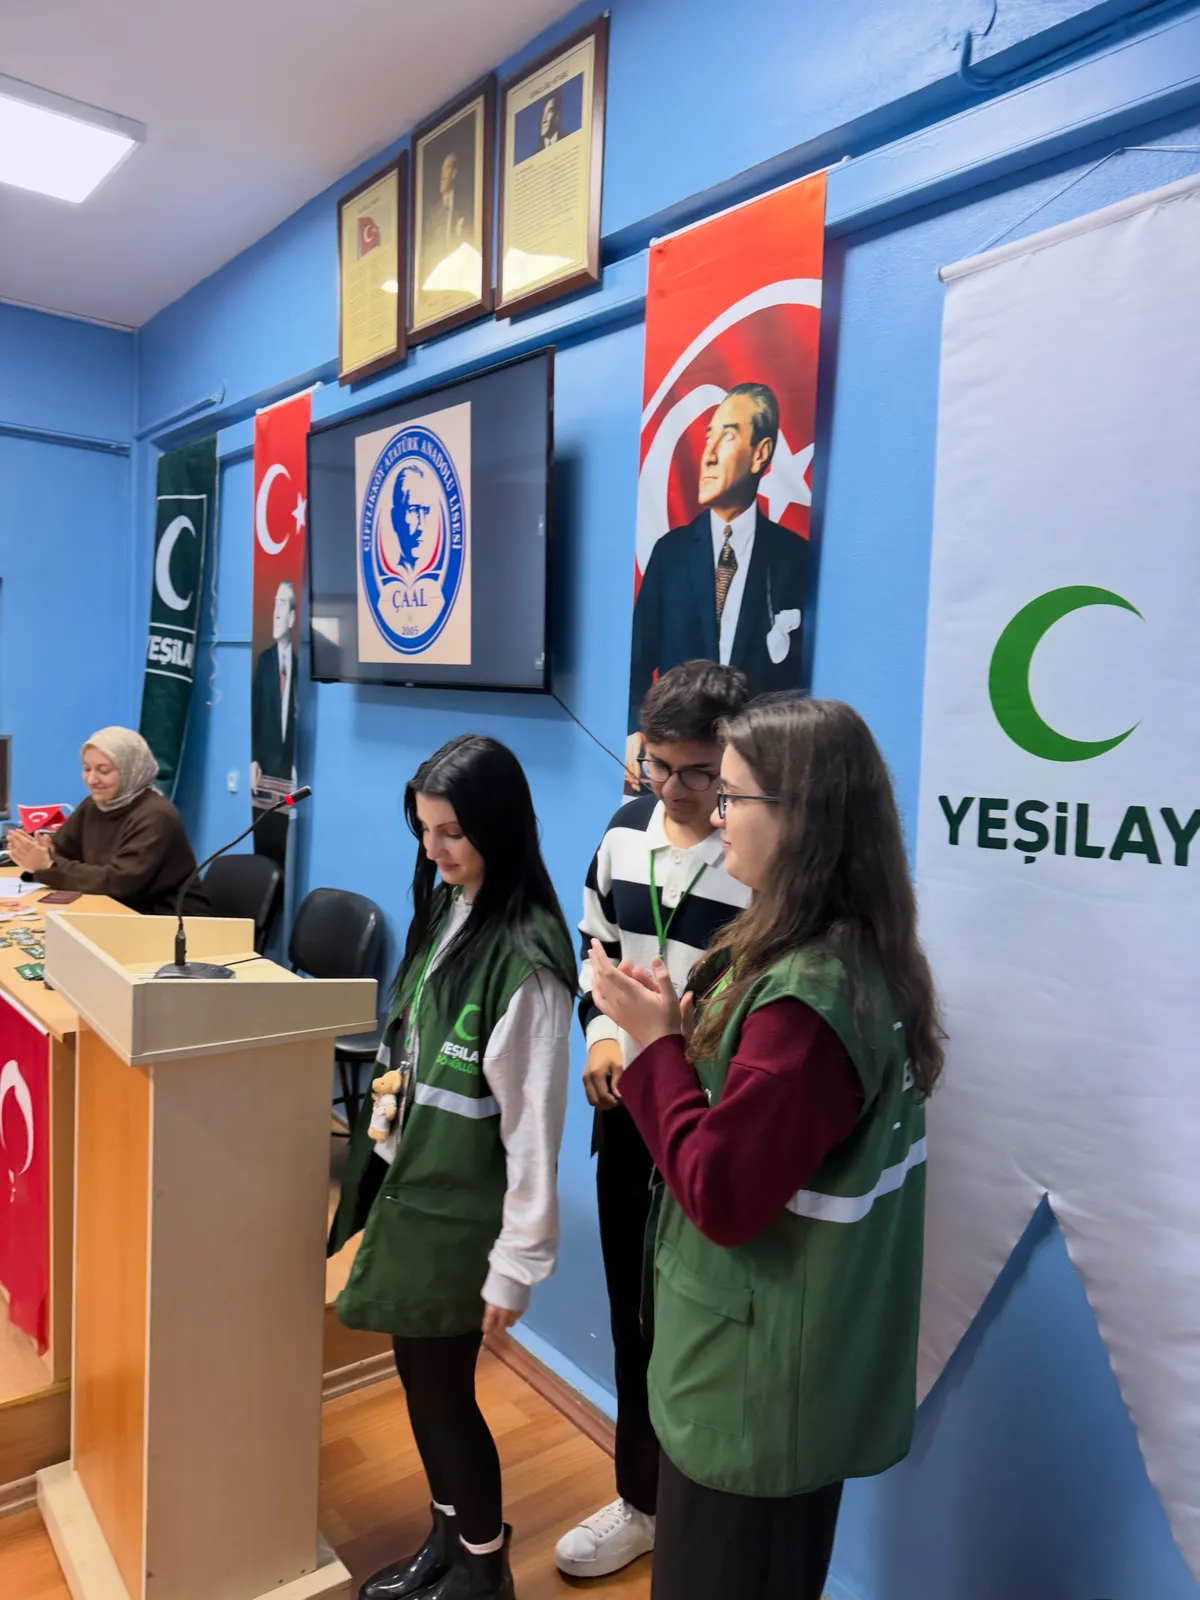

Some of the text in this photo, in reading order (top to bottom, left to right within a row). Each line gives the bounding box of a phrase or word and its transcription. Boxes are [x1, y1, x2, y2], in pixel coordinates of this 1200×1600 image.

[384, 436, 419, 470] ATATÜRK
[420, 440, 455, 491] ANADOLU
[392, 588, 428, 613] ÇAAL
